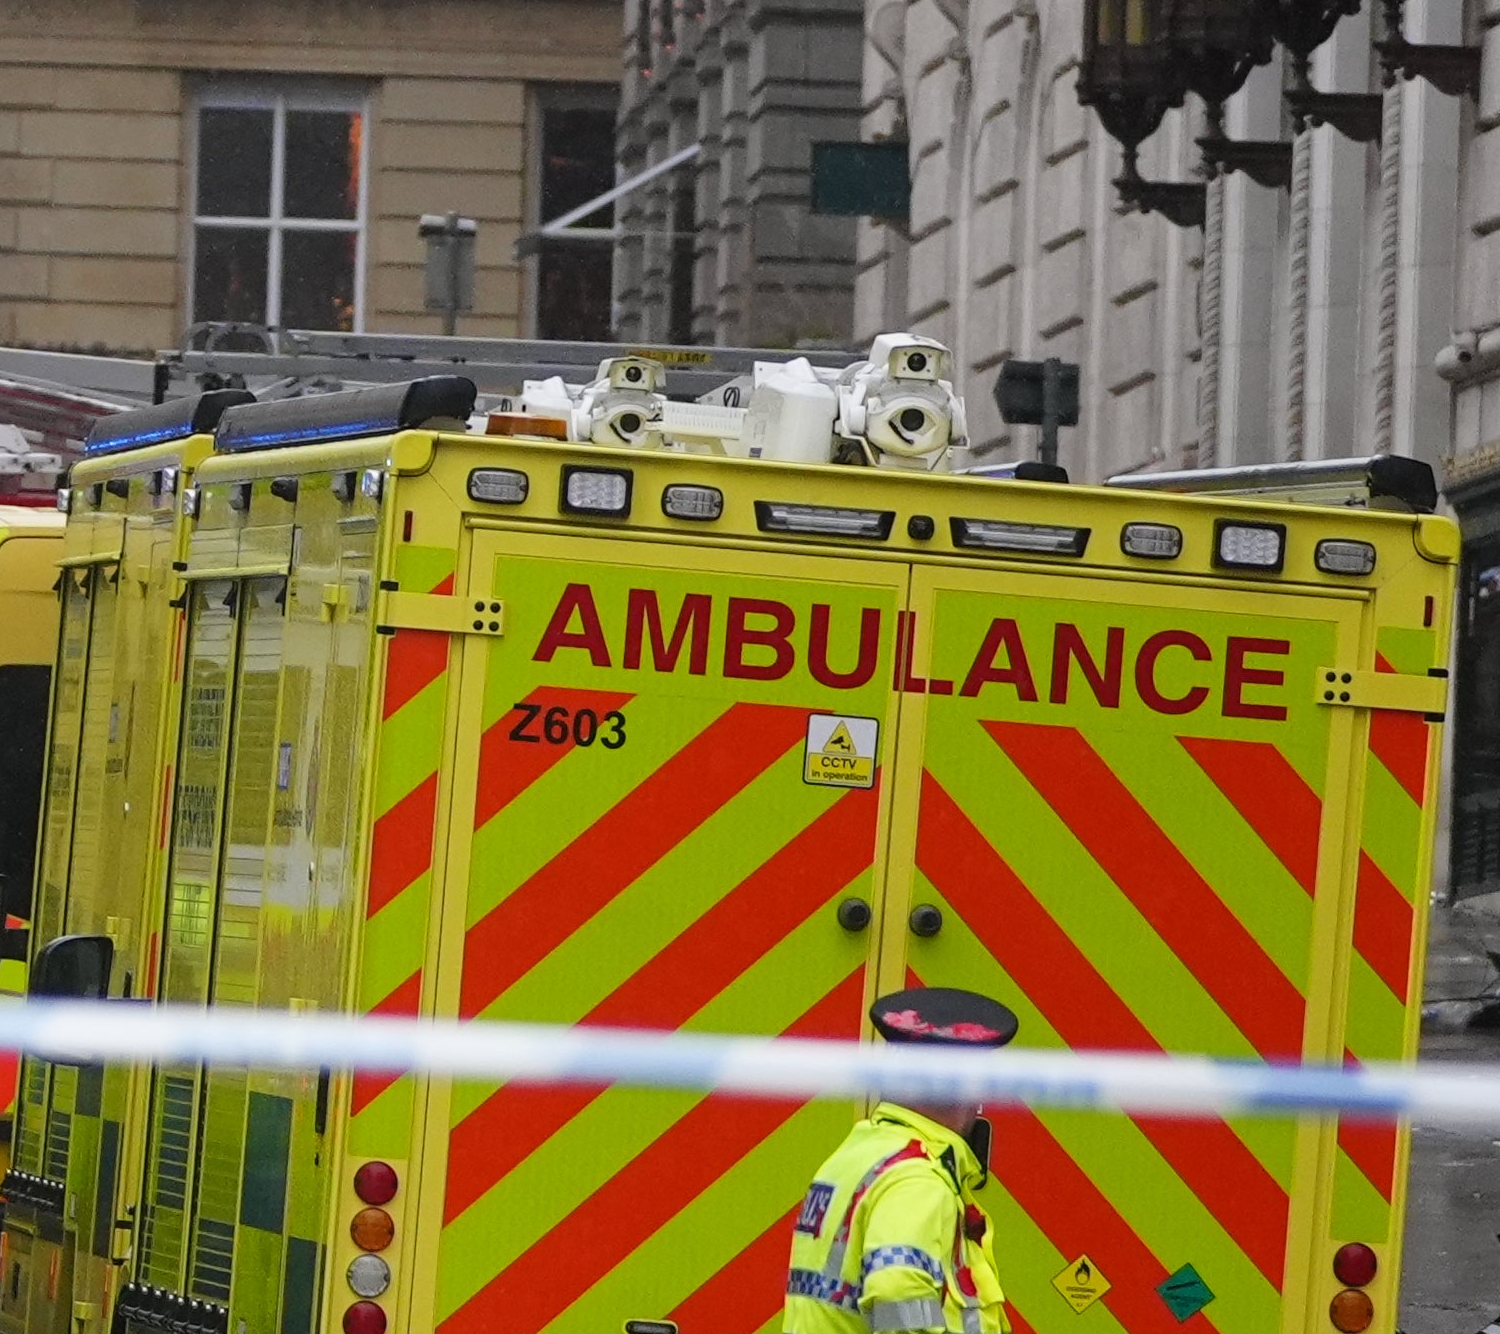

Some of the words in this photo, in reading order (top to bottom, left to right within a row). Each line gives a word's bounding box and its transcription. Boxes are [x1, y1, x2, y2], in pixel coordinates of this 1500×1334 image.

[532, 583, 1292, 722] AMBULANCE
[510, 703, 627, 750] Z603
[811, 769, 820, 778] in
[823, 771, 868, 782] operation
[821, 756, 857, 770] CCTV
